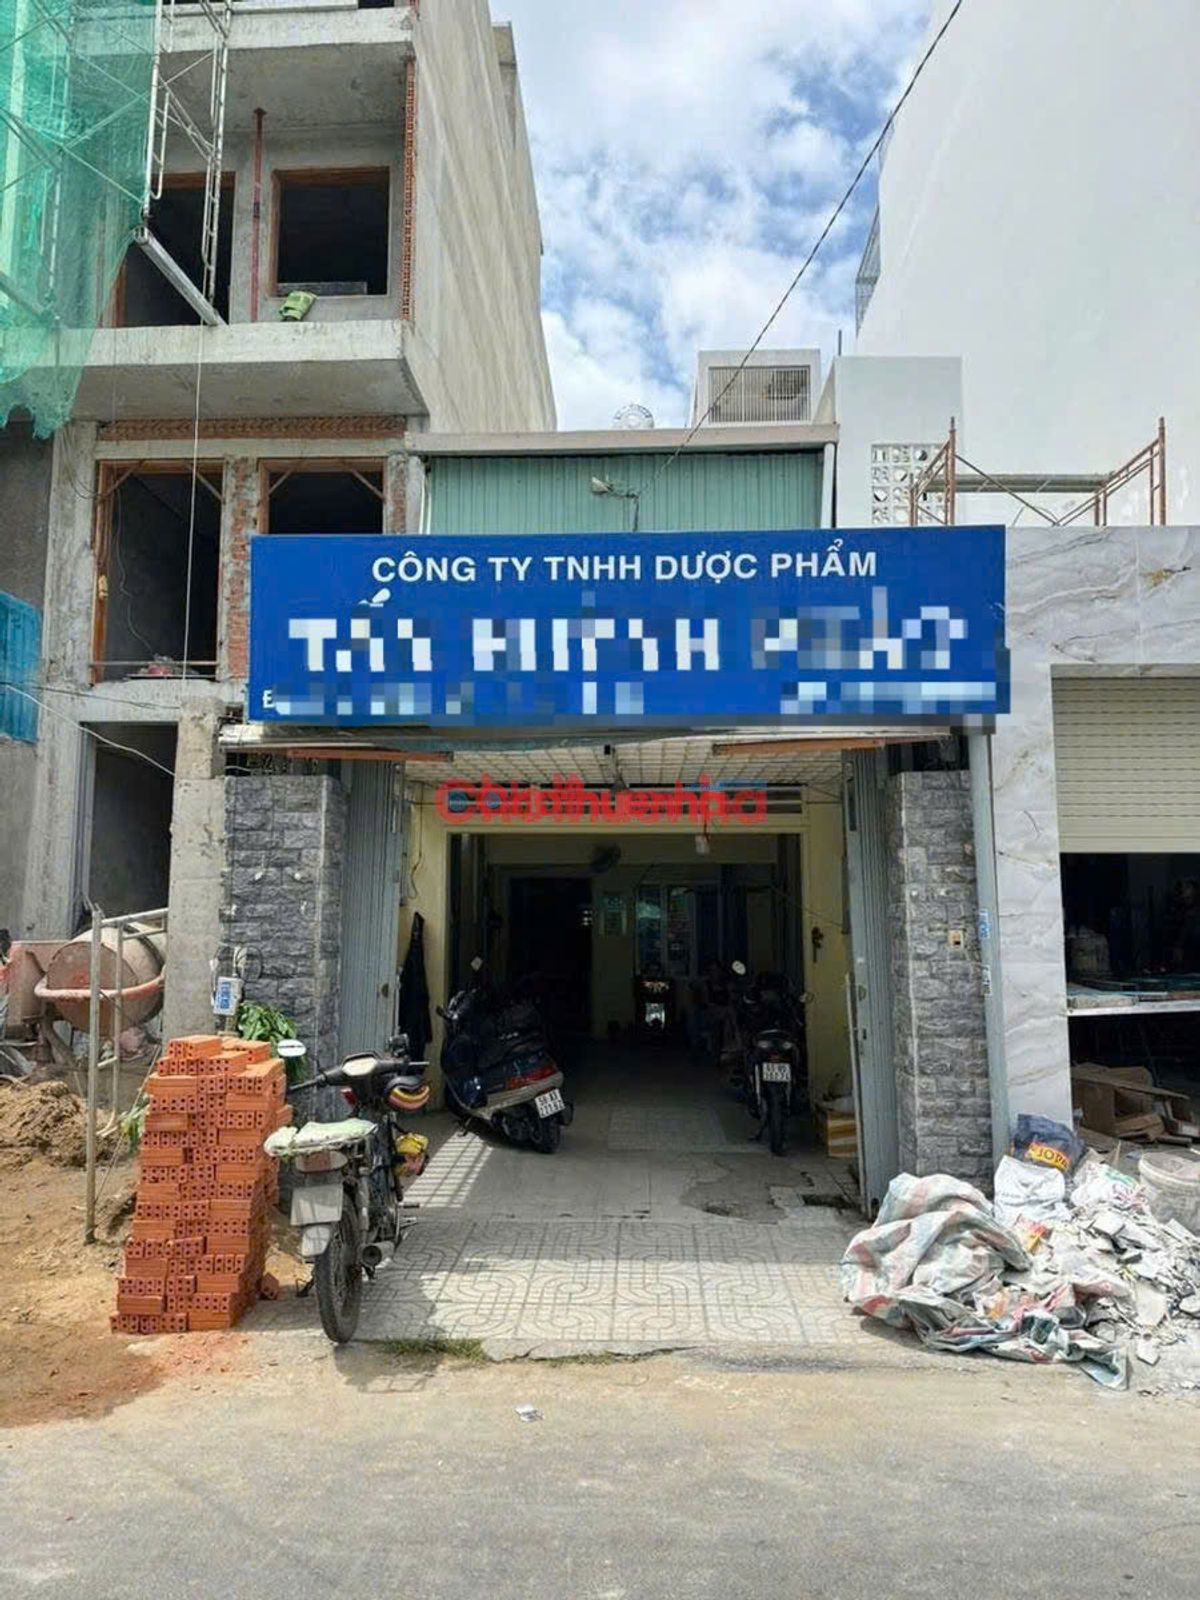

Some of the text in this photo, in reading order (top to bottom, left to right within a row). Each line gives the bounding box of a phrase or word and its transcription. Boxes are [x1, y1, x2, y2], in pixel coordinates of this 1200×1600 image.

[371, 538, 877, 584] CÔNG TY TNHH DƯỢC PHẨM
